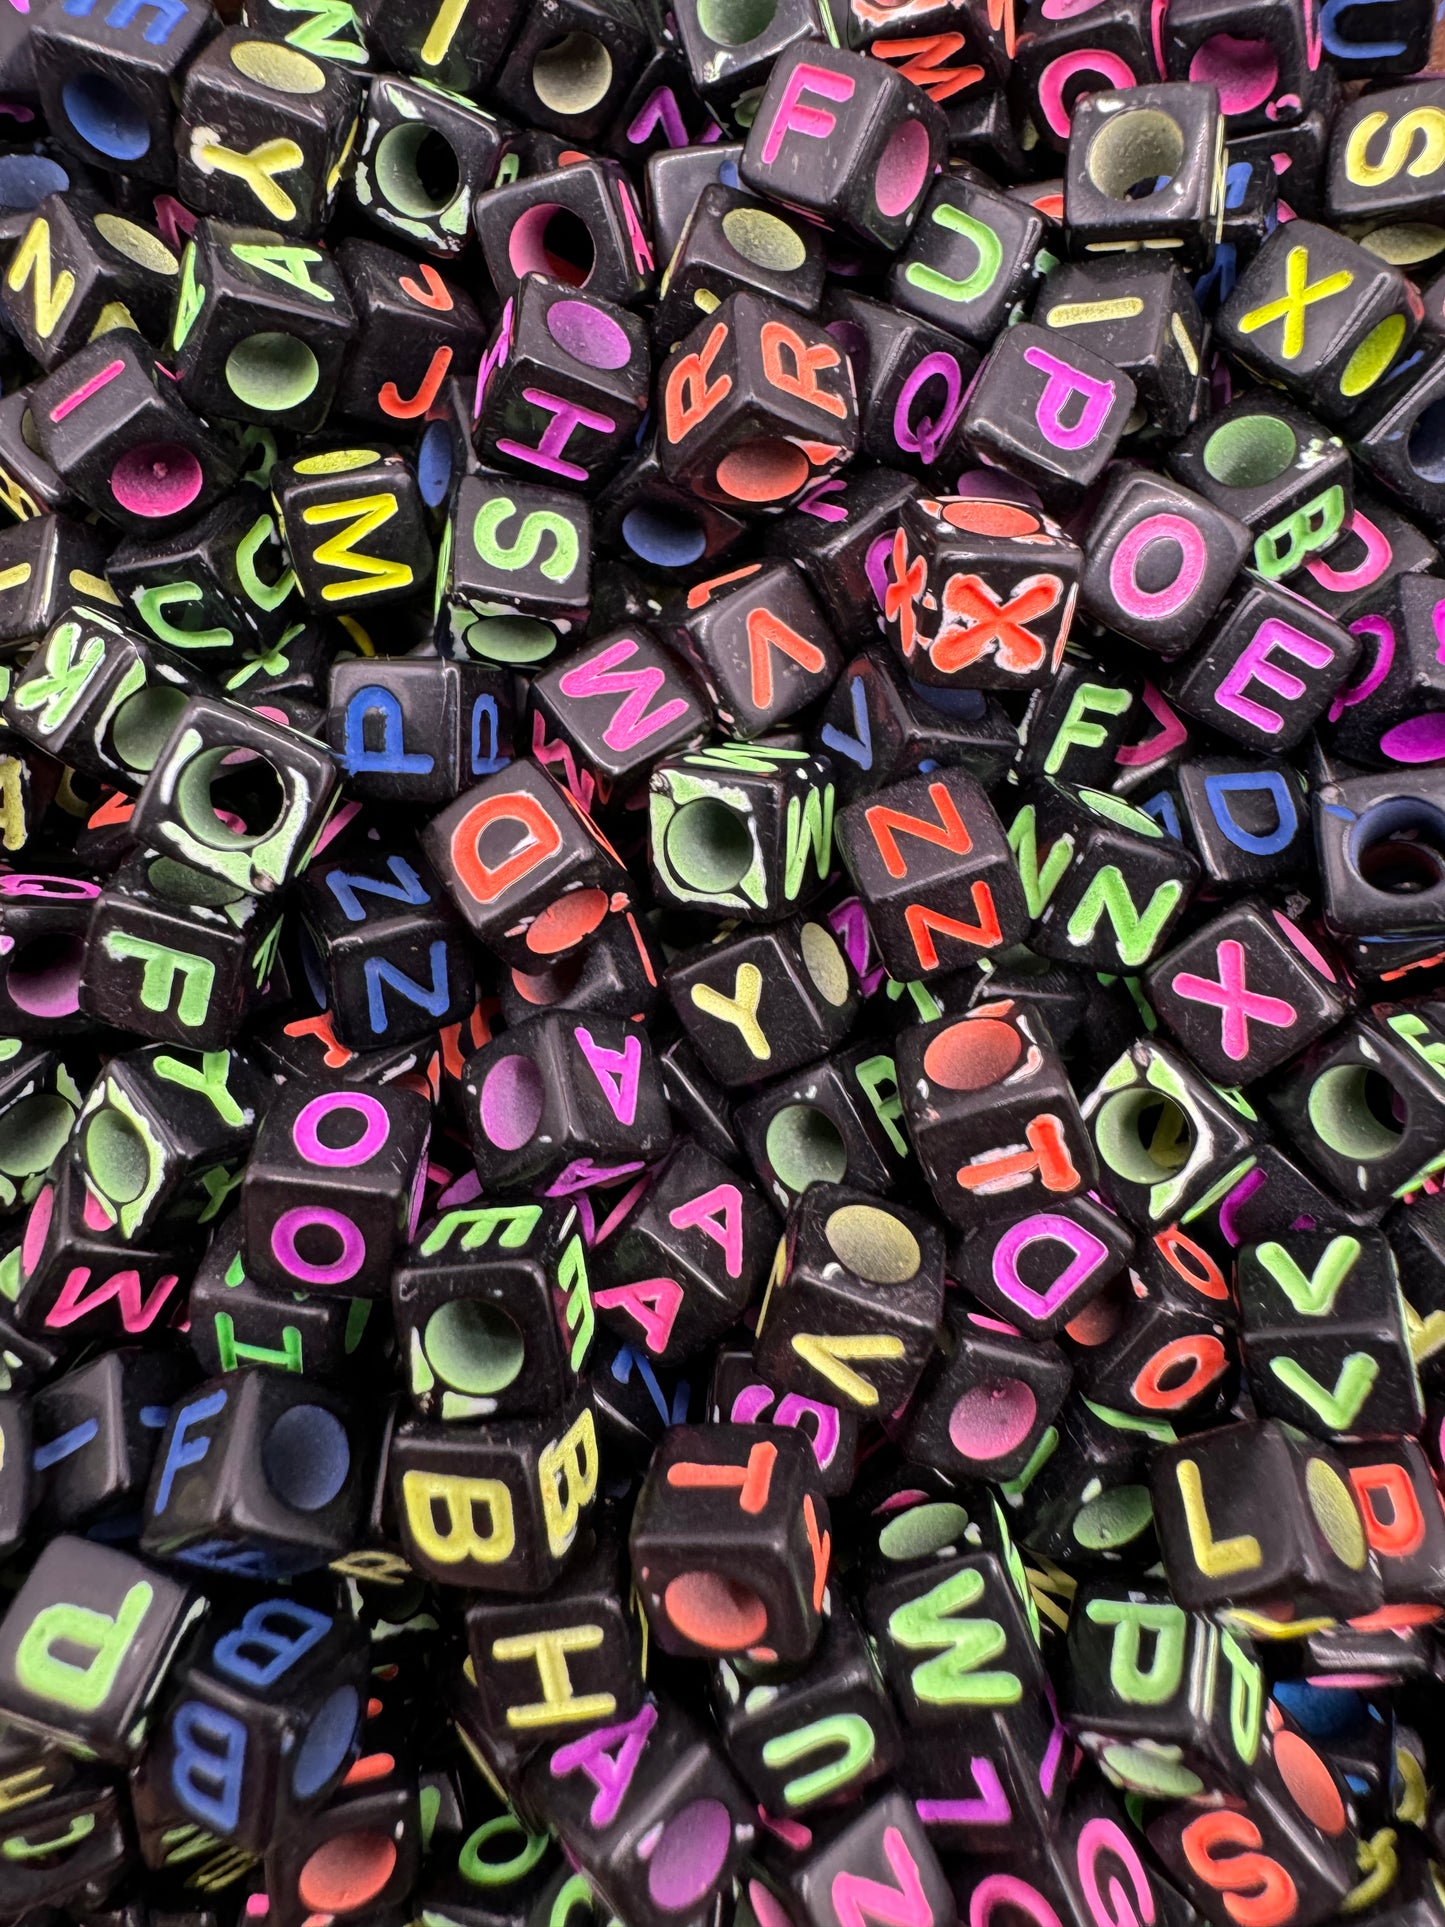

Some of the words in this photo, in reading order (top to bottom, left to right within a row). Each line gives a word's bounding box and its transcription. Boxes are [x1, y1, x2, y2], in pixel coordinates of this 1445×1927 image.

[760, 62, 856, 165] F
[1345, 105, 1445, 187] S
[190, 126, 304, 222] Y
[8, 217, 76, 339] N
[230, 242, 335, 303] A
[905, 202, 1003, 302] U
[1046, 296, 1144, 328] I
[1238, 245, 1355, 360] X
[49, 359, 126, 424] I
[377, 345, 454, 419] J
[665, 321, 733, 444] R
[760, 321, 849, 420] R
[893, 351, 962, 465] Q
[1023, 346, 1117, 450] P
[495, 387, 617, 481] H
[473, 497, 579, 584] S
[1109, 513, 1207, 621] O
[1254, 484, 1345, 581] B
[745, 607, 826, 710] V
[930, 572, 1064, 674] X
[821, 675, 873, 771] V
[1214, 617, 1336, 734] E
[343, 684, 435, 777] P
[1043, 682, 1134, 775] F
[450, 790, 563, 905] D
[865, 782, 973, 879] N
[1205, 770, 1299, 856] D
[325, 855, 432, 922] N
[1007, 804, 1074, 920] N
[904, 880, 1004, 972] N
[1067, 864, 1183, 967] N
[102, 931, 216, 1028] F
[364, 939, 450, 1034] N
[691, 962, 772, 1061] Y
[1172, 938, 1298, 1061] X
[152, 1049, 245, 1128] Y
[573, 1026, 642, 1126] A
[292, 1091, 391, 1168] O
[956, 1112, 1081, 1196] T
[271, 1205, 366, 1285] O
[420, 1205, 544, 1257] E
[669, 1183, 743, 1279] A
[992, 1213, 1109, 1320] D
[1153, 1222, 1230, 1301] O
[1255, 1235, 1361, 1317] V
[594, 1277, 685, 1354] A
[791, 1332, 906, 1407] V
[1132, 1334, 1230, 1410] O
[1269, 1350, 1380, 1431] V
[154, 1388, 228, 1517] F
[538, 1407, 600, 1560] B
[667, 1440, 779, 1515] T
[402, 1470, 517, 1566] B
[1176, 1458, 1263, 1579] L
[15, 1579, 154, 1713] P
[212, 1597, 335, 1689] B
[491, 1623, 618, 1730] H
[1085, 1597, 1188, 1708] P
[171, 1700, 249, 1835] B
[549, 1702, 659, 1829] A
[762, 1712, 876, 1808] U
[1181, 1810, 1299, 1927] S
